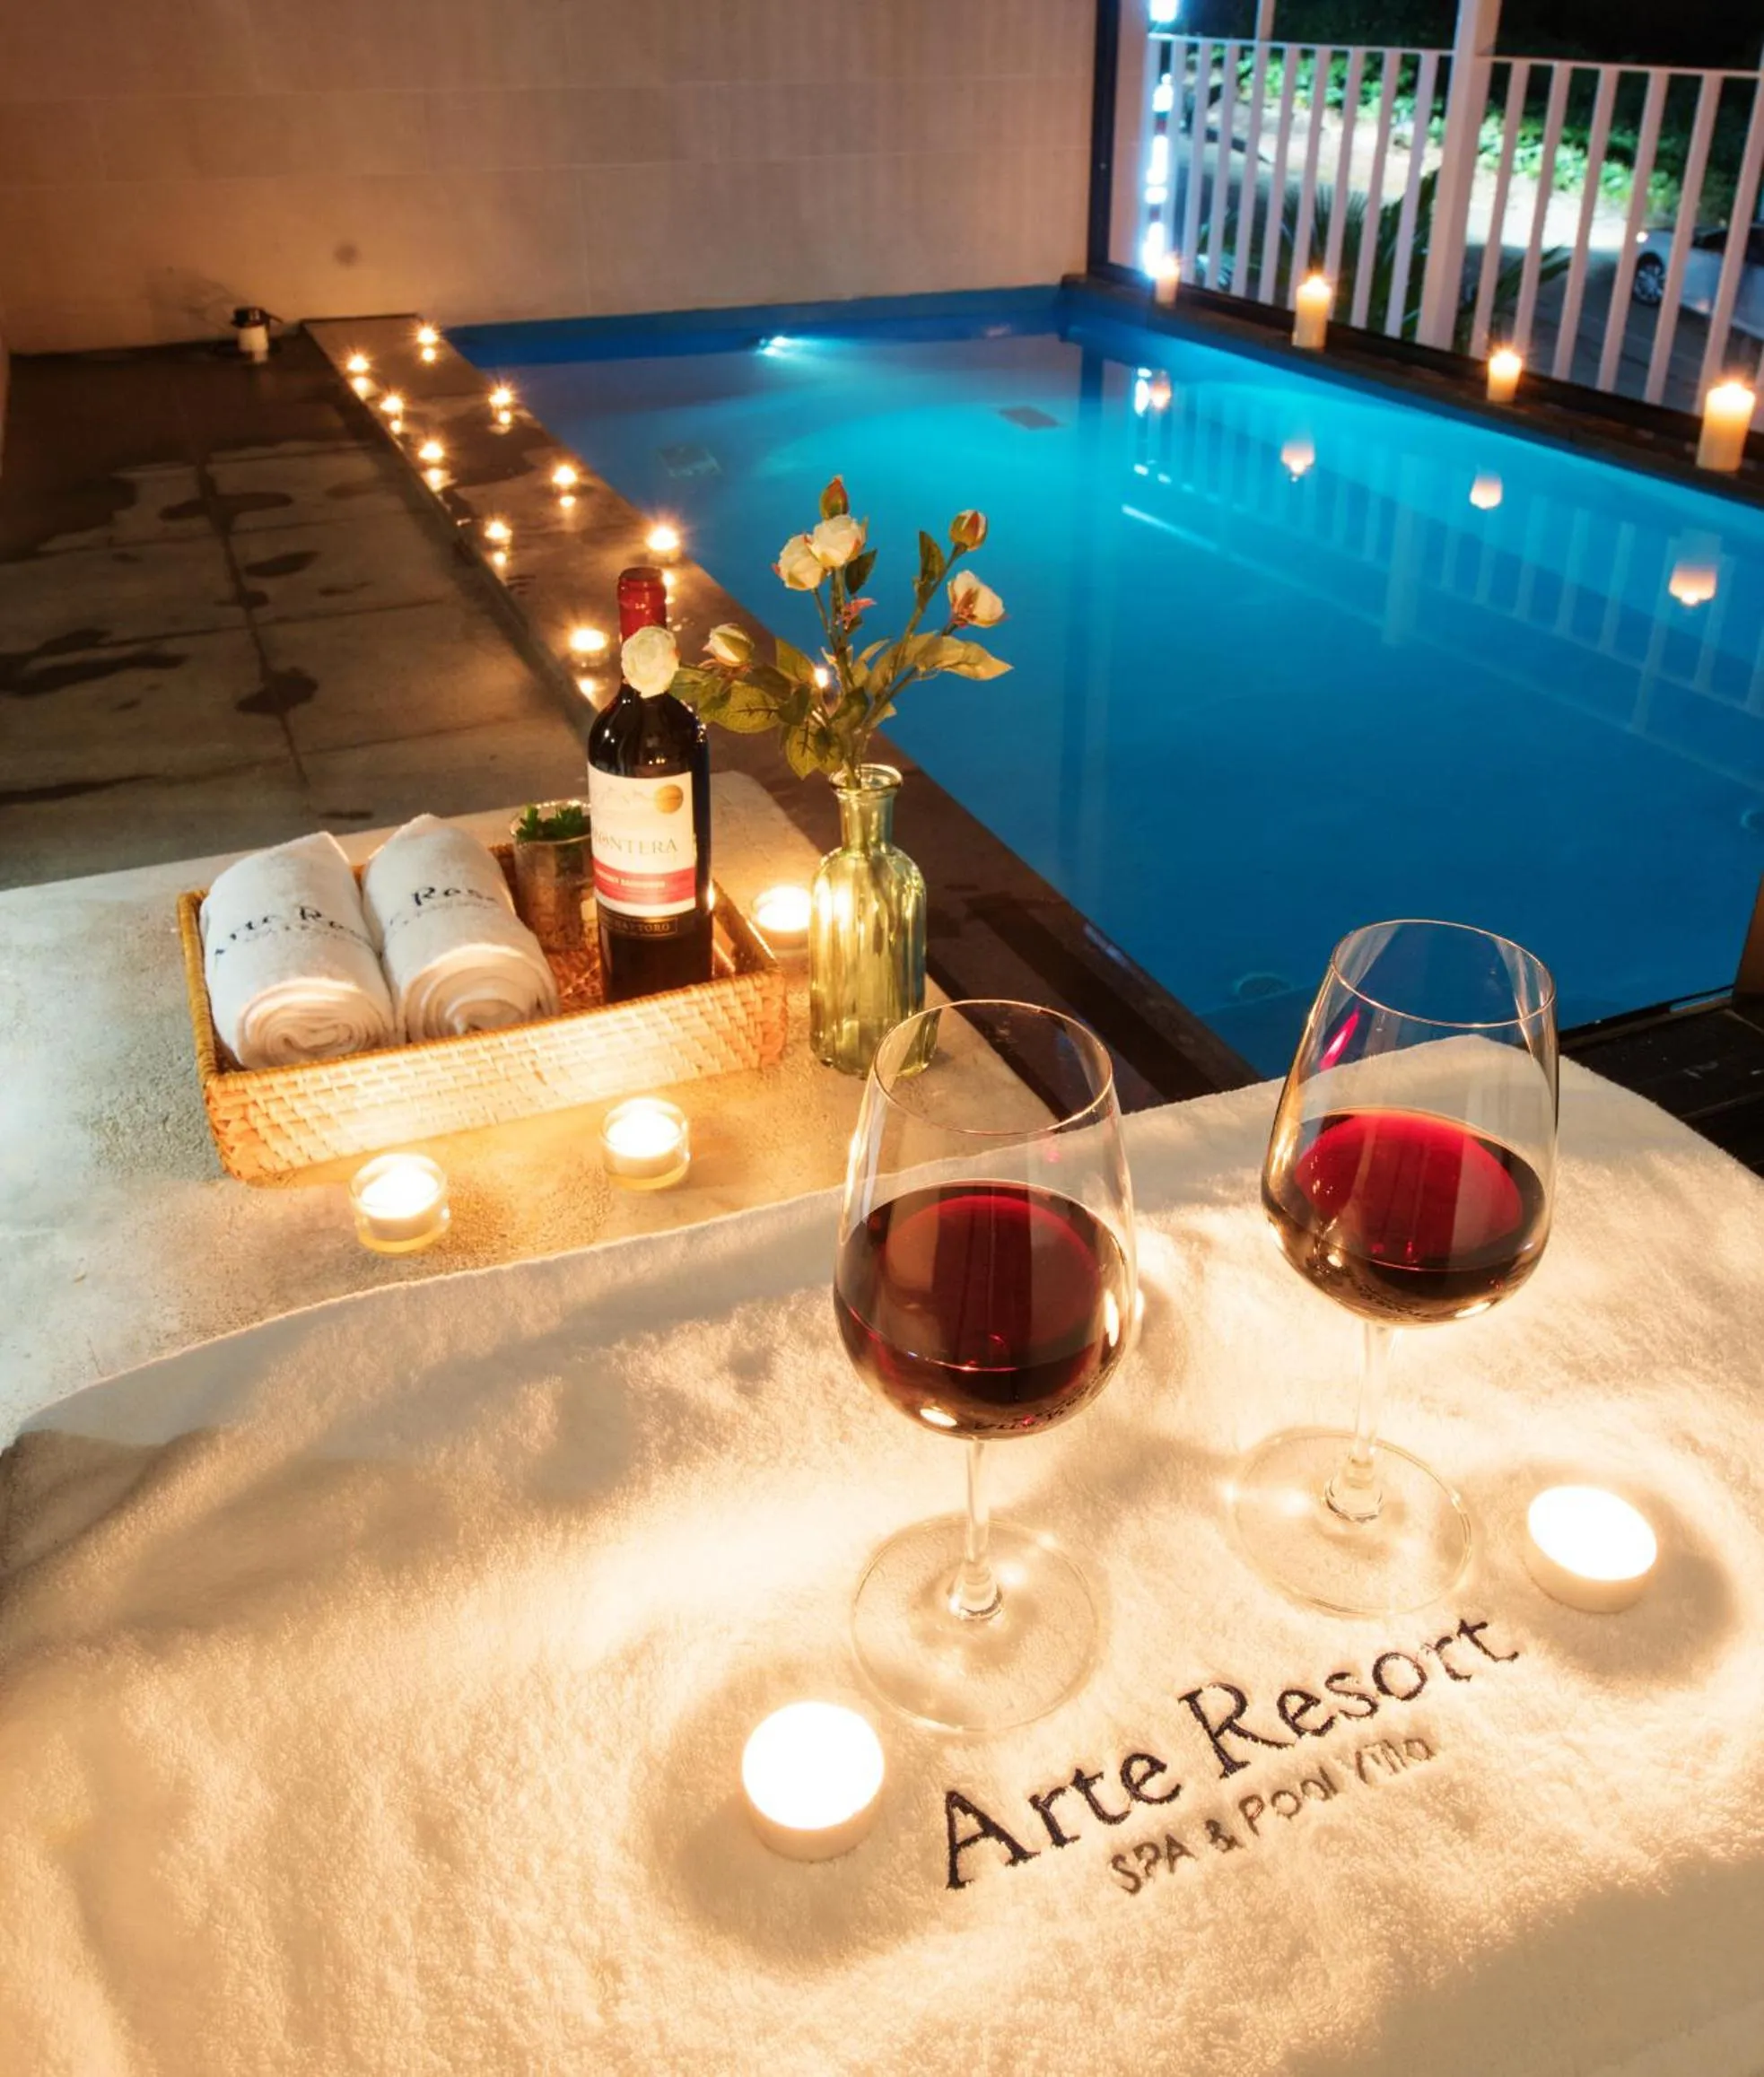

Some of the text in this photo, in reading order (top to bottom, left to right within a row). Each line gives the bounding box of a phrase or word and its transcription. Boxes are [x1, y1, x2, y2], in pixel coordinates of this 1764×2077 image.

[944, 1617, 1519, 1889] Arte Resort
[1111, 1833, 1197, 1896] SPA
[1204, 1819, 1244, 1854] &
